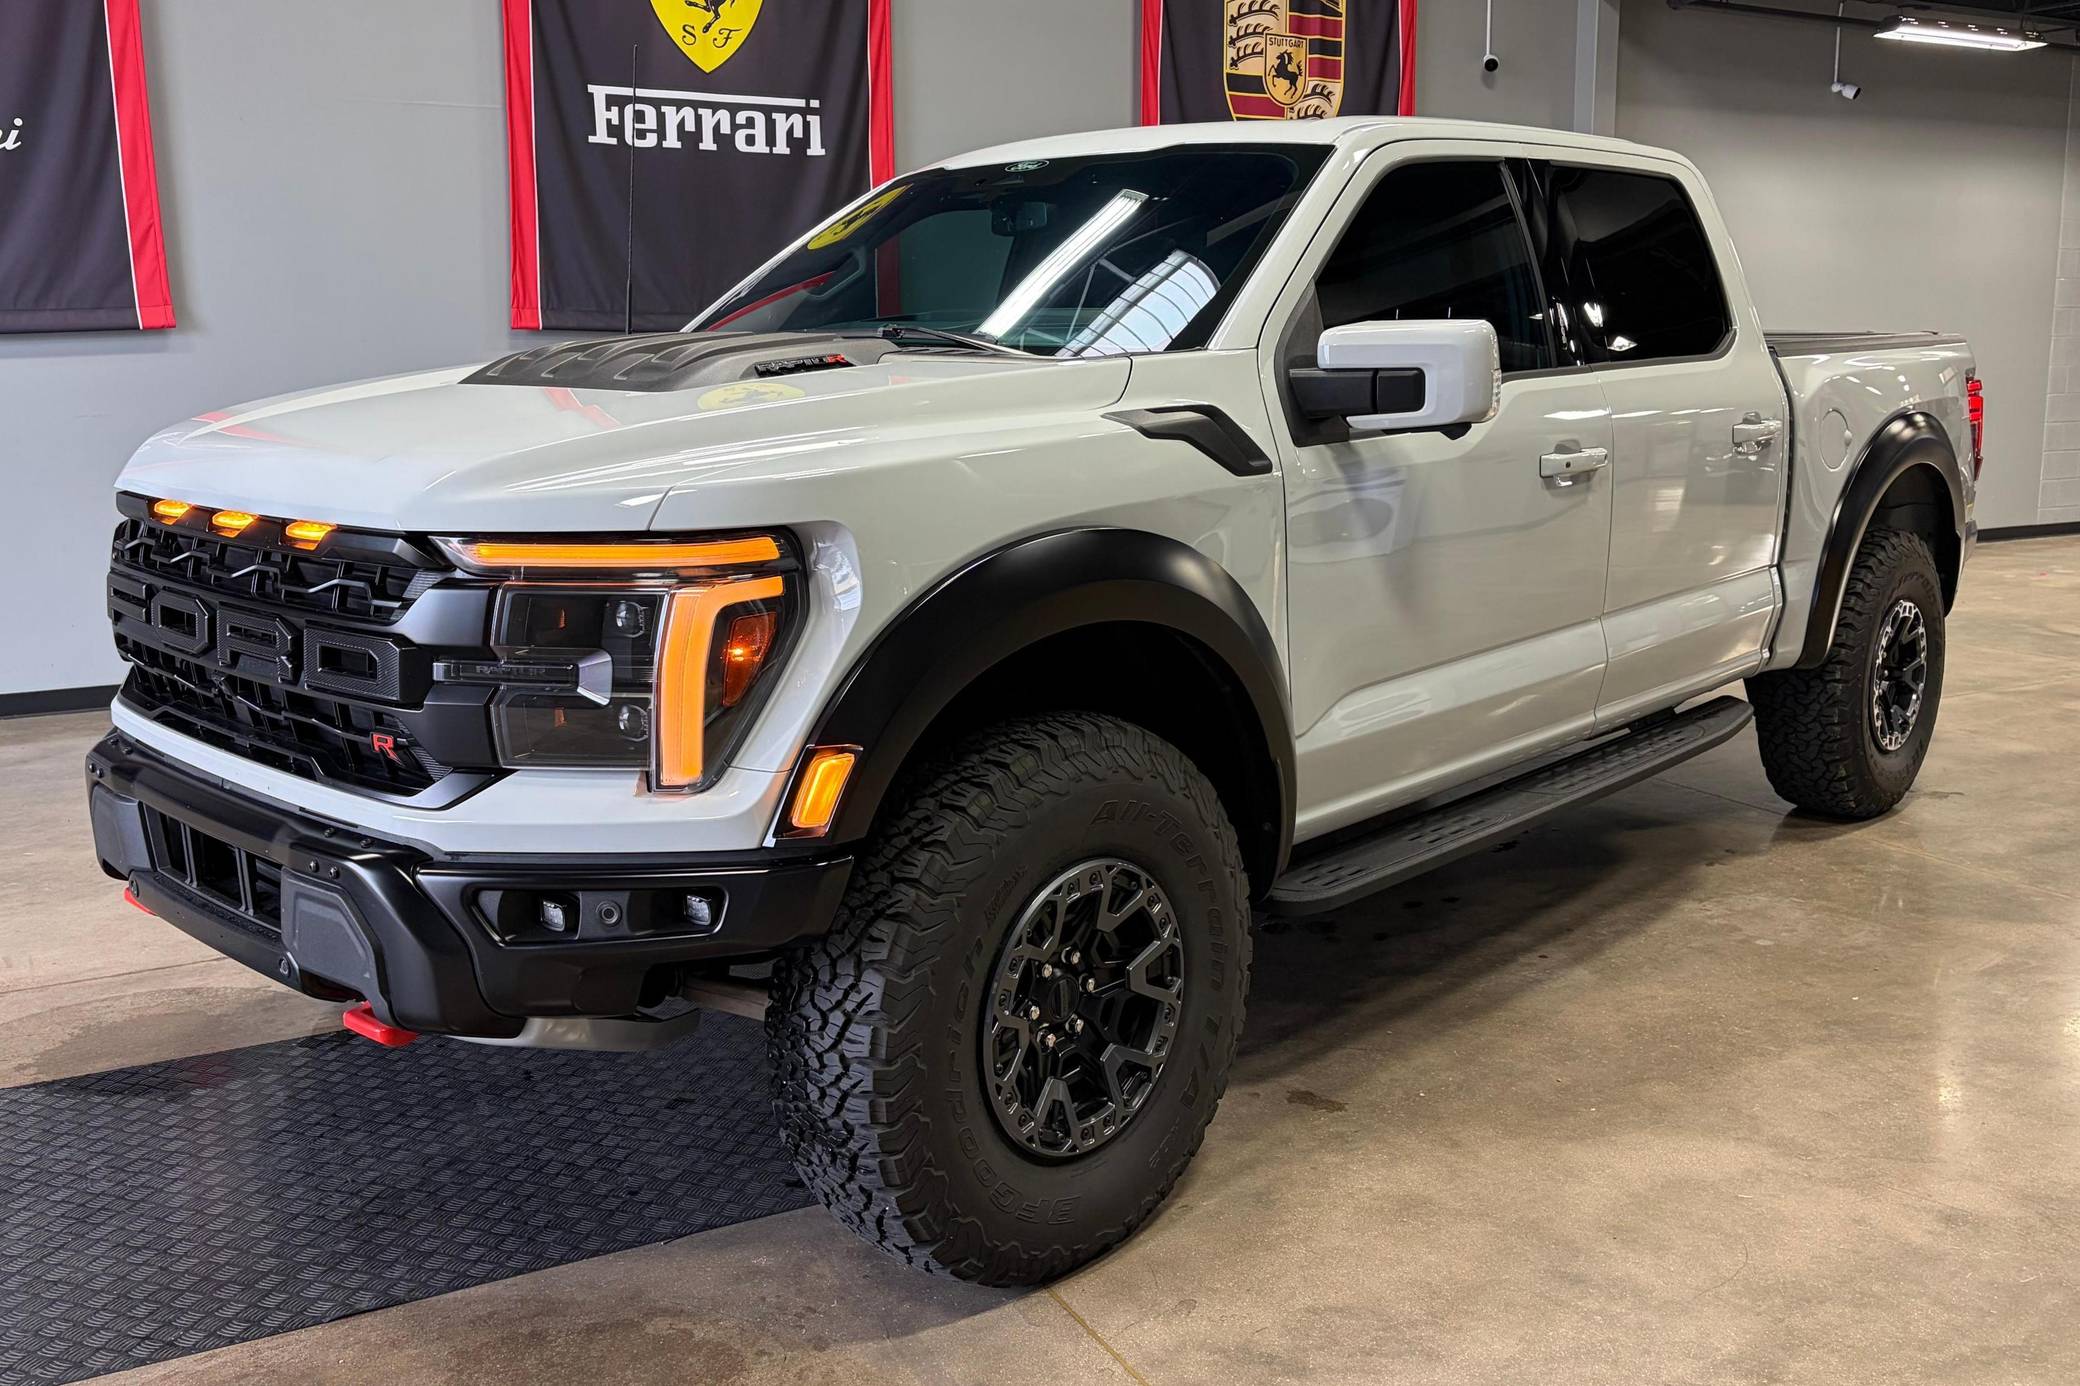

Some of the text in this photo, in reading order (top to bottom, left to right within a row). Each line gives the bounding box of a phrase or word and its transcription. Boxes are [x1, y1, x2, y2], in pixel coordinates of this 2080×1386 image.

[681, 24, 697, 46] S
[1268, 36, 1305, 49] STUTTGART
[587, 84, 826, 156] Ferrari
[106, 571, 404, 702] FORD
[370, 732, 404, 766] R
